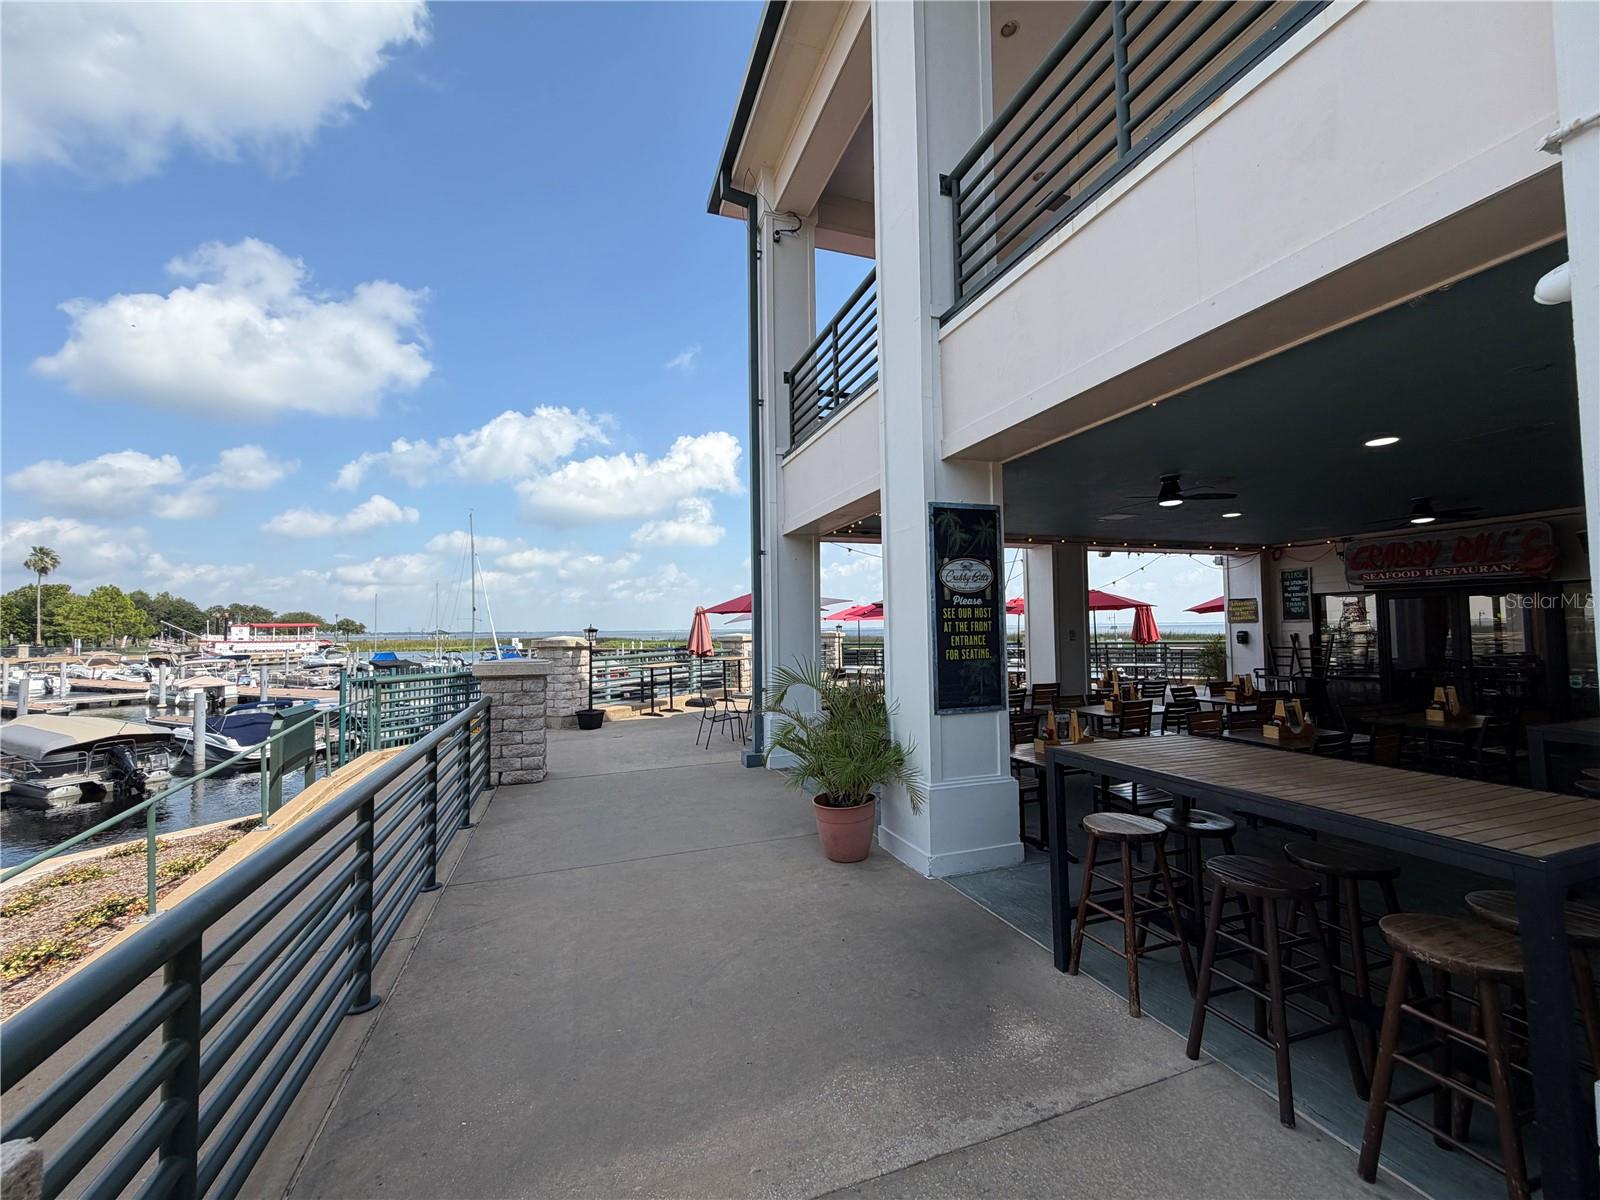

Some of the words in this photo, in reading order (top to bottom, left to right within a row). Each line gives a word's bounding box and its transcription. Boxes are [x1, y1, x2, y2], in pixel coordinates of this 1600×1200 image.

[1361, 569, 1420, 581] SEAFOOD
[952, 595, 983, 605] Please
[942, 607, 956, 619] SEE
[958, 607, 972, 618] OUR
[974, 607, 992, 618] HOST
[943, 621, 952, 633] AT
[955, 621, 968, 633] THE
[970, 620, 992, 632] FRONT
[950, 634, 987, 646] ENTRANCE
[945, 649, 960, 661] FOR
[961, 648, 992, 660] SEATING.
